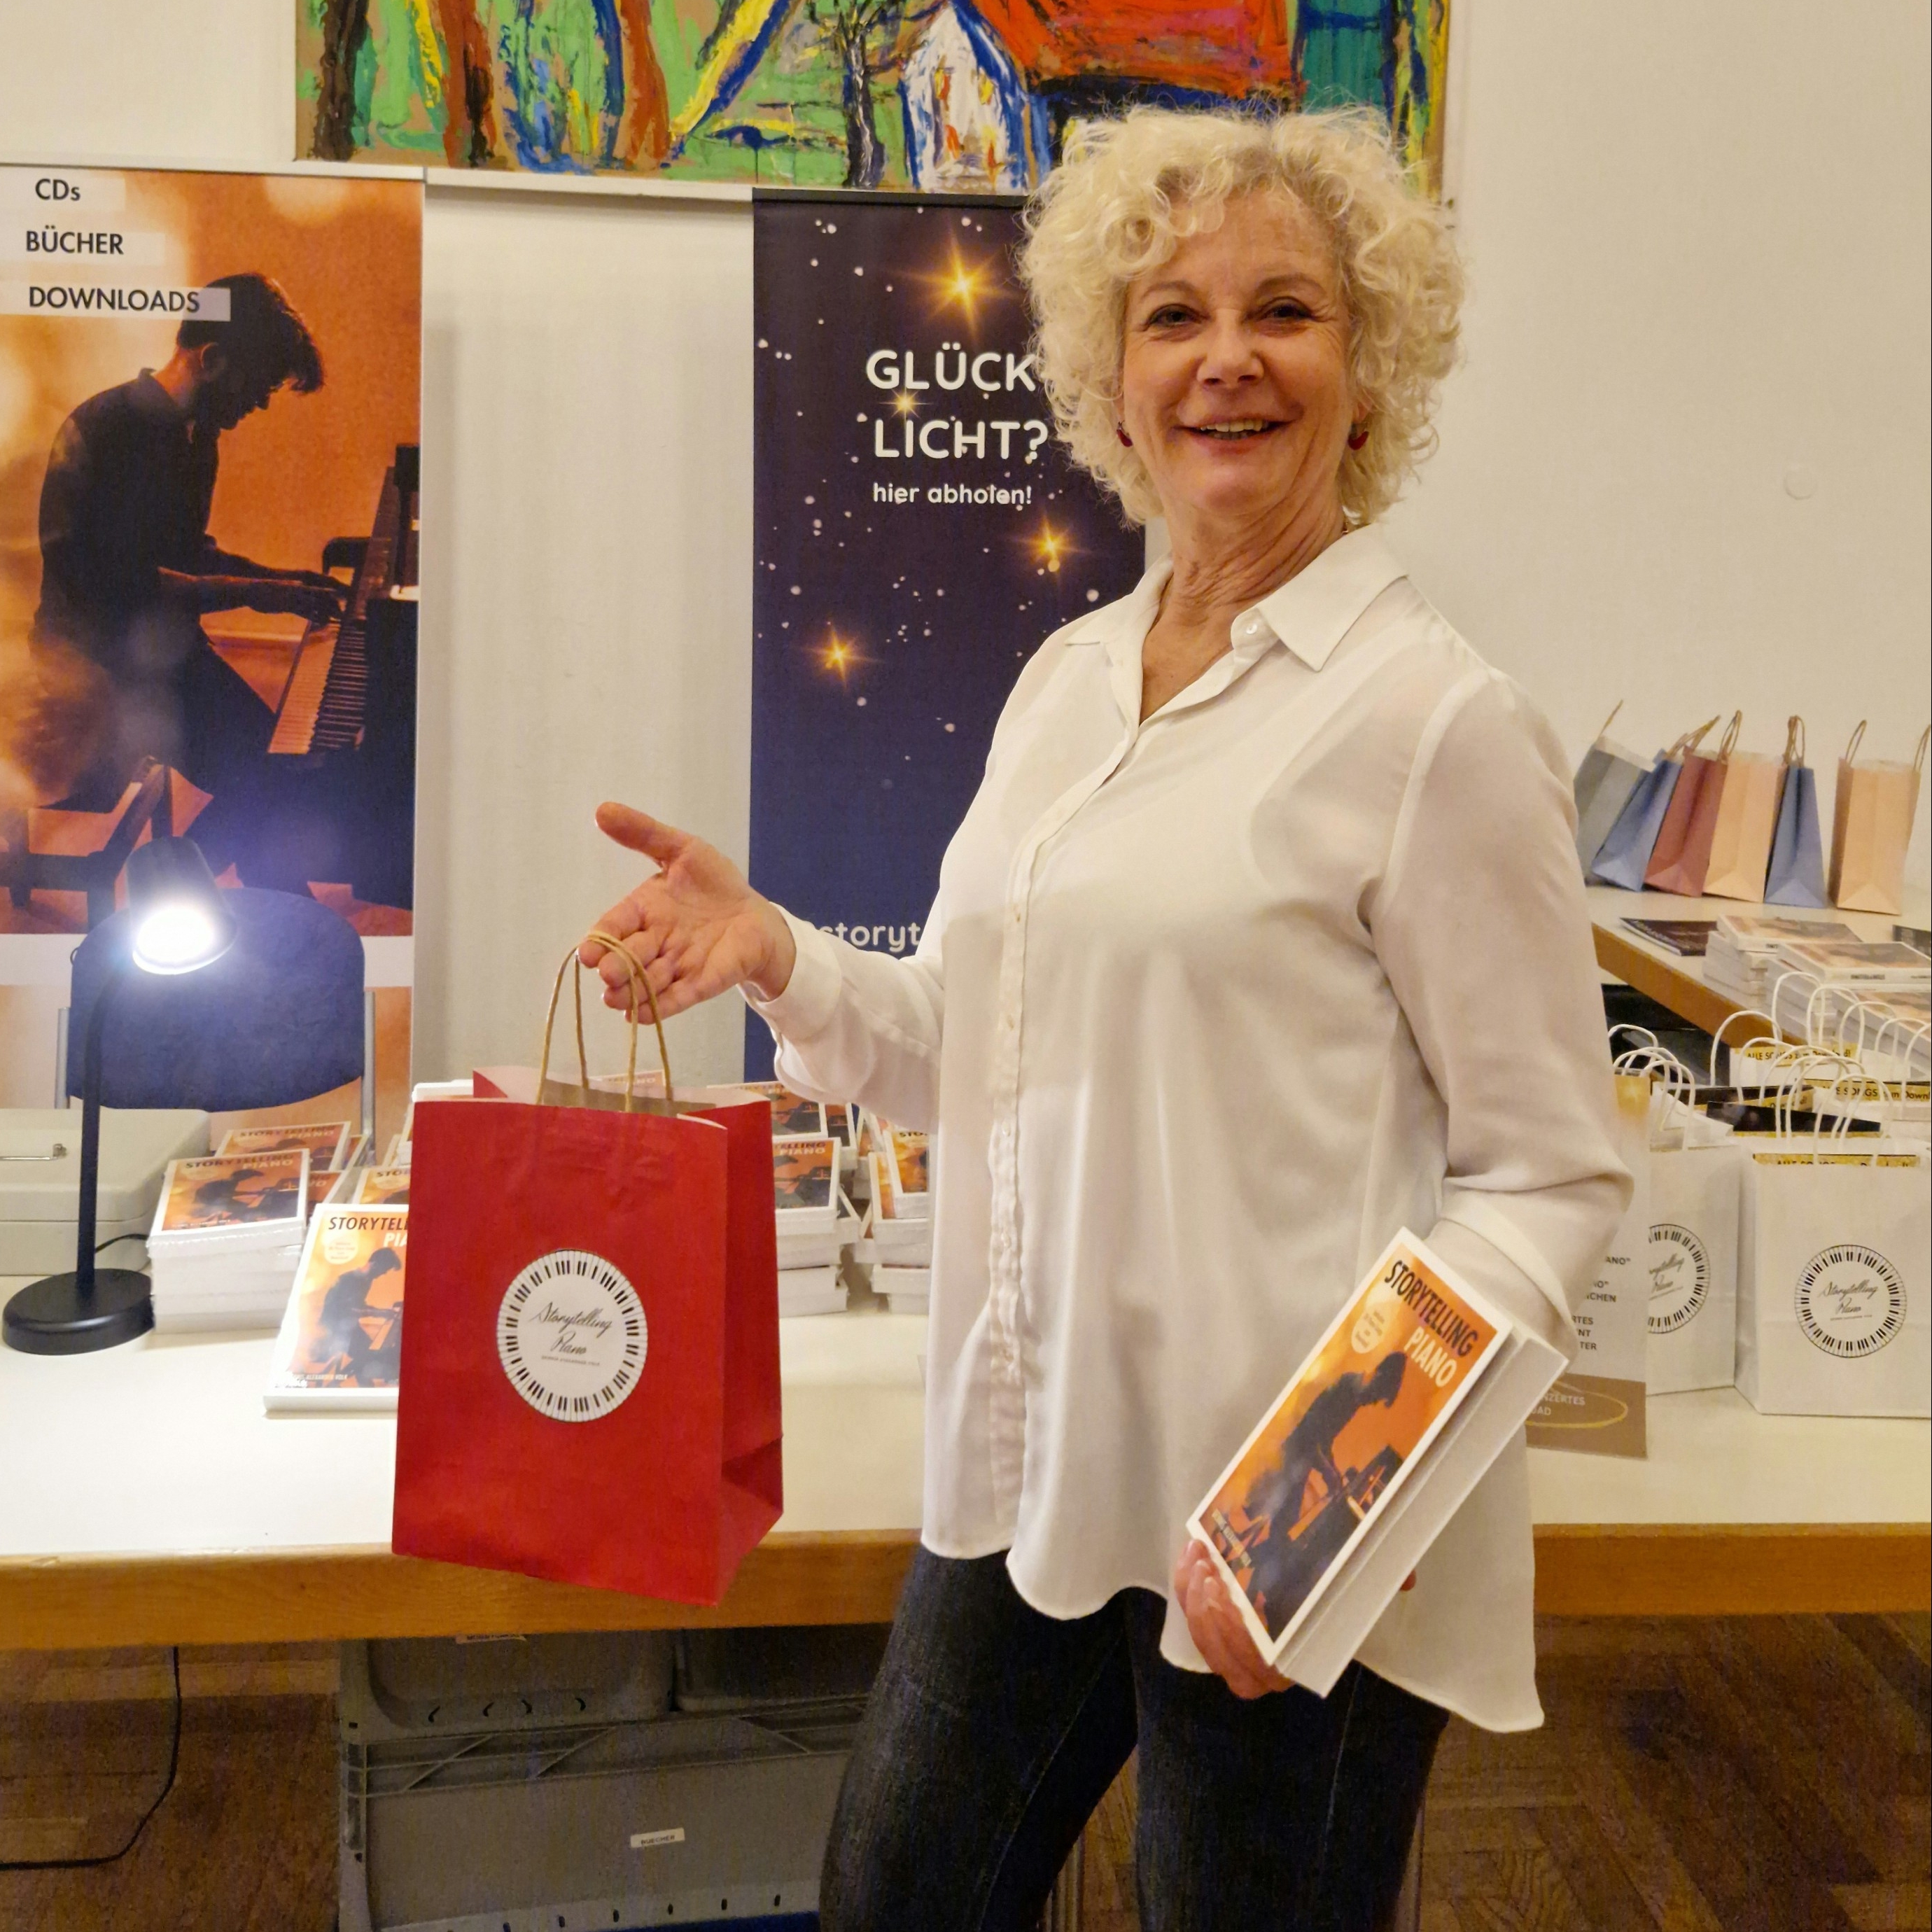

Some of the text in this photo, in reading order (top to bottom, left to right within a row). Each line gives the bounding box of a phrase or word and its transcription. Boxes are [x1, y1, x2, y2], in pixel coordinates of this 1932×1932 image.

[35, 178, 81, 201] CDs
[26, 225, 124, 255] BÜCHER
[29, 286, 200, 313] DOWNLOADS
[866, 342, 1037, 391] GLÜCK
[874, 419, 1049, 460] LICHT?
[873, 482, 1032, 505] hier abholen!
[242, 1158, 294, 1170] PIANO
[528, 1301, 613, 1338] Storytelling
[1384, 1260, 1478, 1357] STORYTELLING
[550, 1331, 587, 1354] Piano
[1403, 1326, 1457, 1387] PIANO
